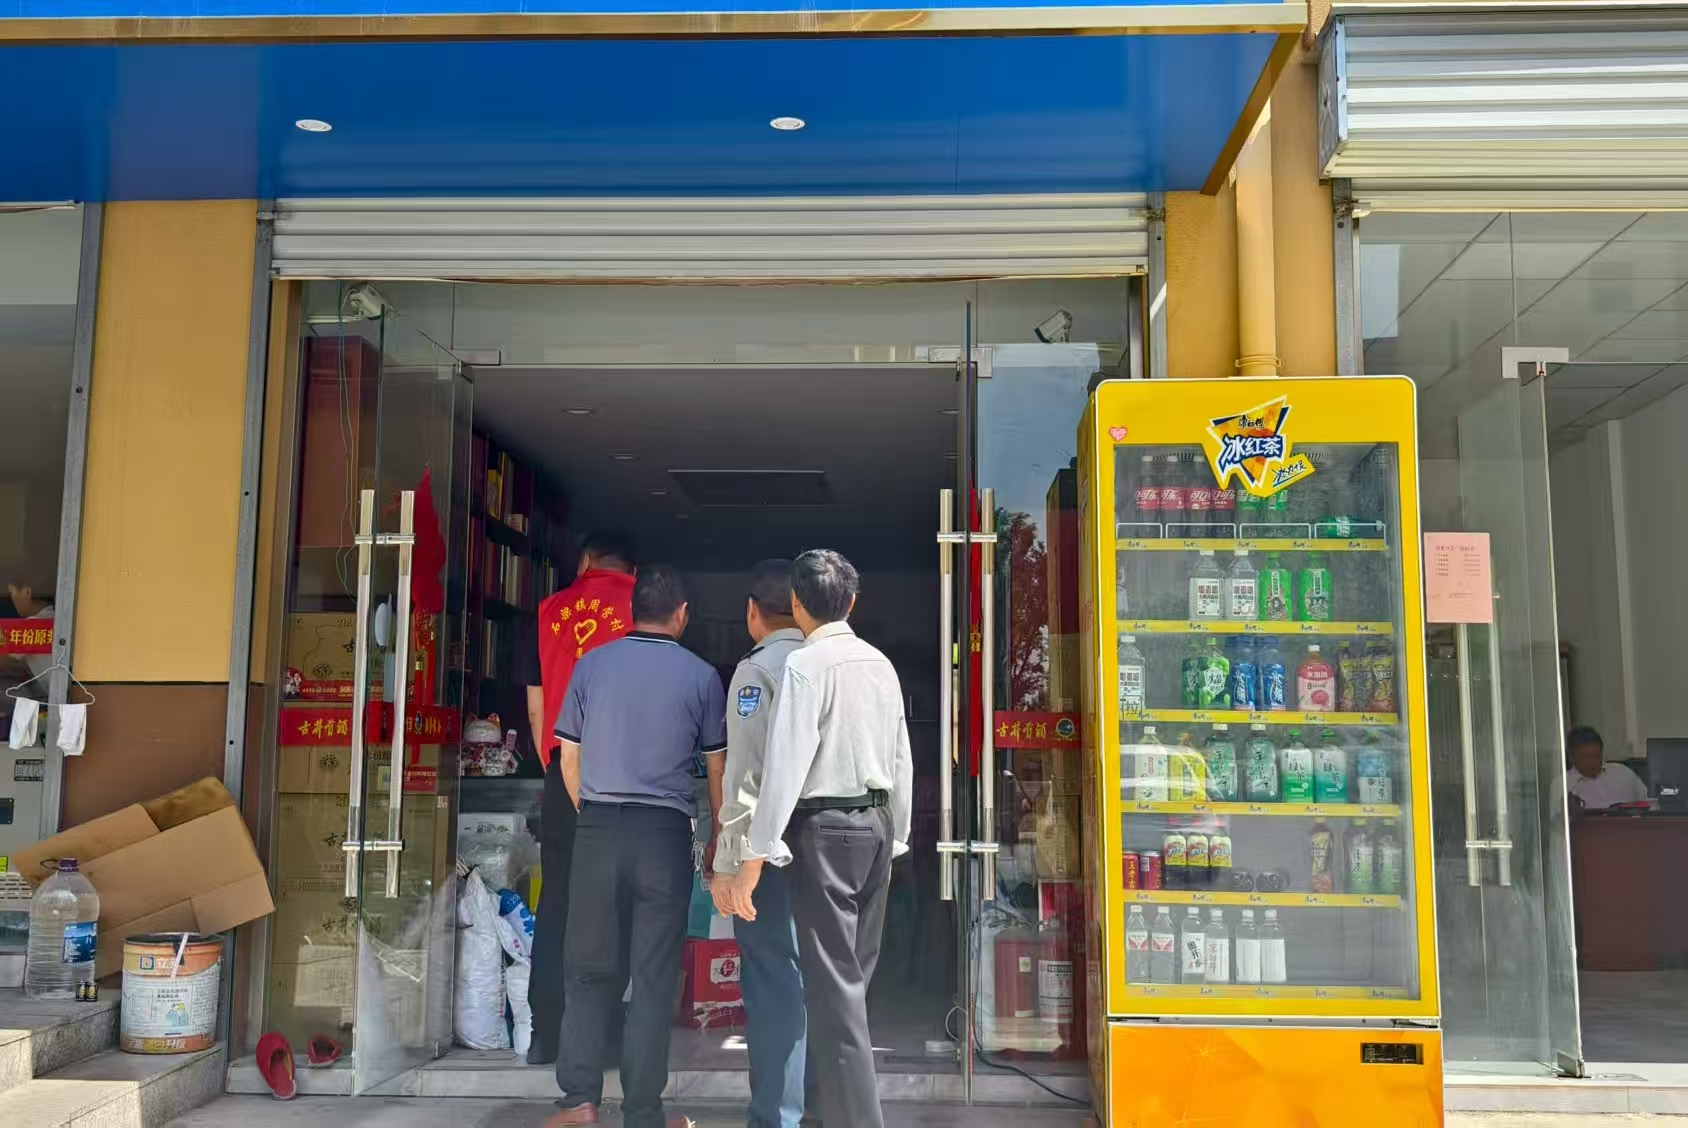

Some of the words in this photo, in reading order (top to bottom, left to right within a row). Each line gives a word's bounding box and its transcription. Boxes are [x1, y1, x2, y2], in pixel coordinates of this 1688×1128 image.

[1219, 436, 1281, 466] 冰红茶
[297, 719, 349, 741] 古井贡酒
[996, 721, 1048, 744] 古井贡酒
